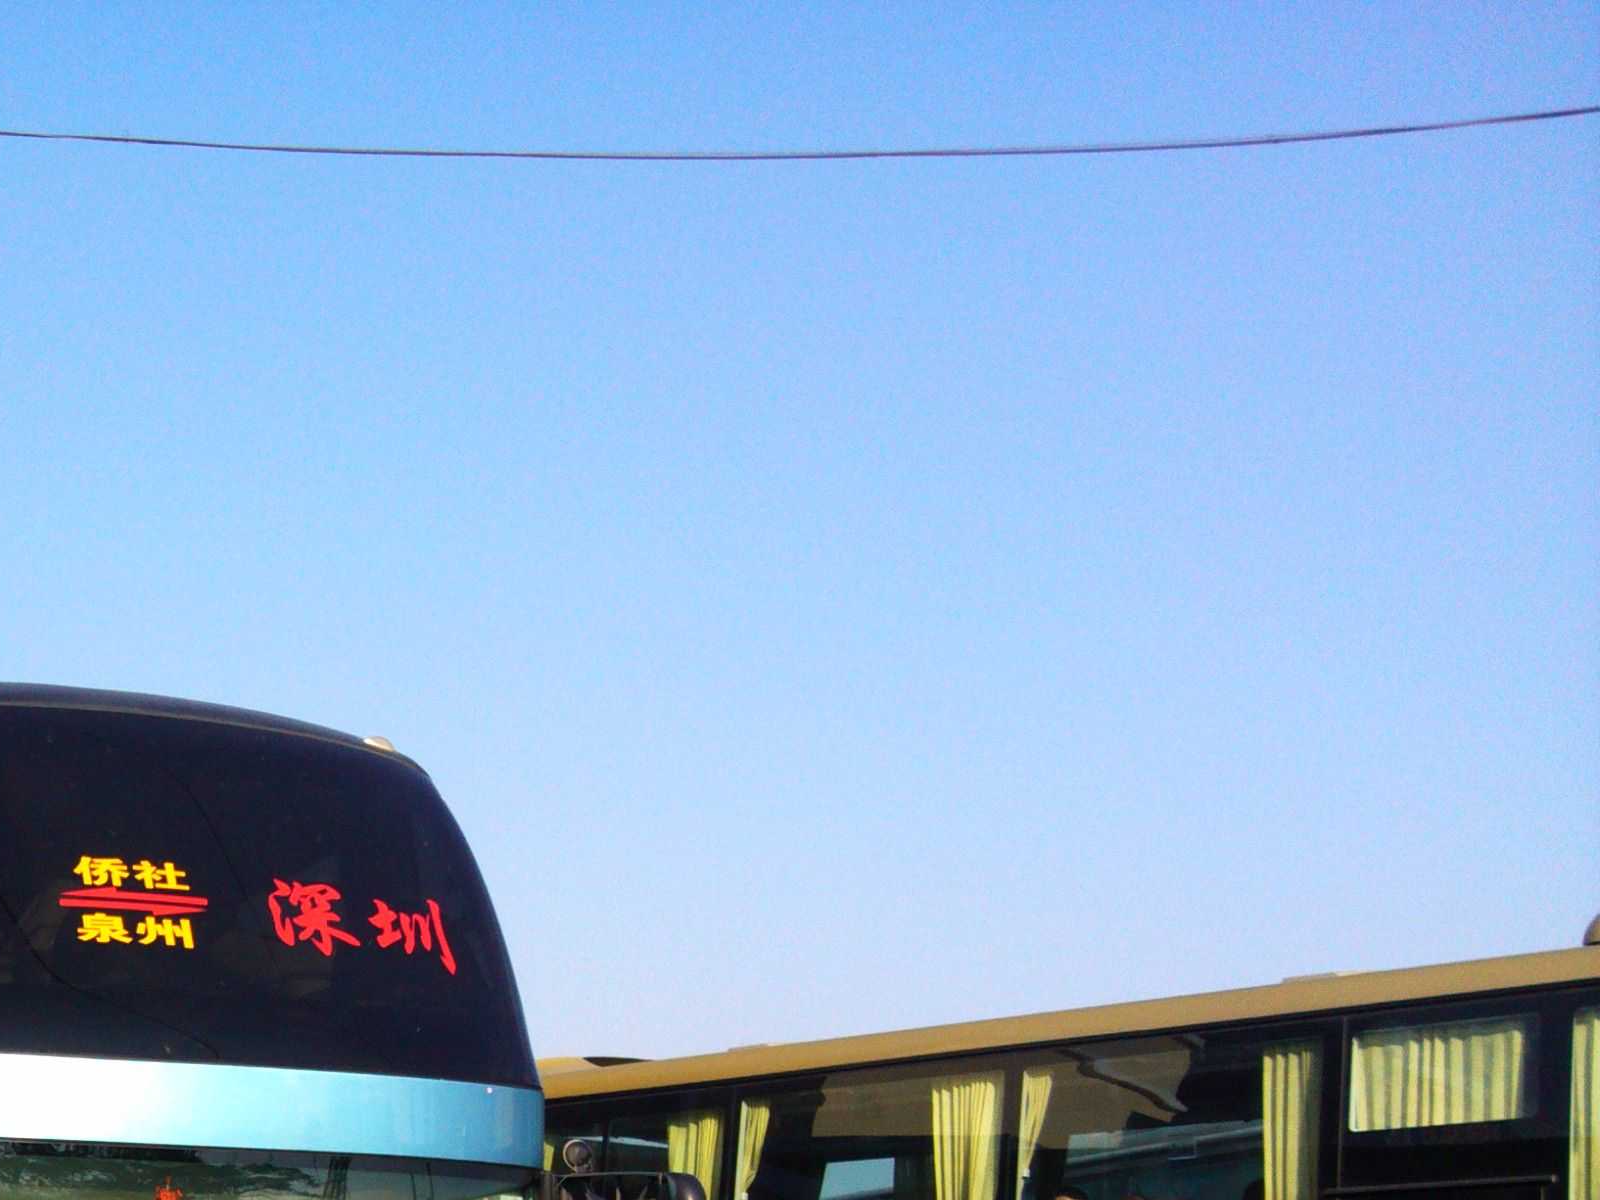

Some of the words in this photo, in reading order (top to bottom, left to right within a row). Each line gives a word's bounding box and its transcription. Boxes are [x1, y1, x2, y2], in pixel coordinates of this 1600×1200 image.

[73, 855, 190, 890] 侨社
[77, 913, 195, 950] 泉州
[267, 878, 457, 975] 深圳
